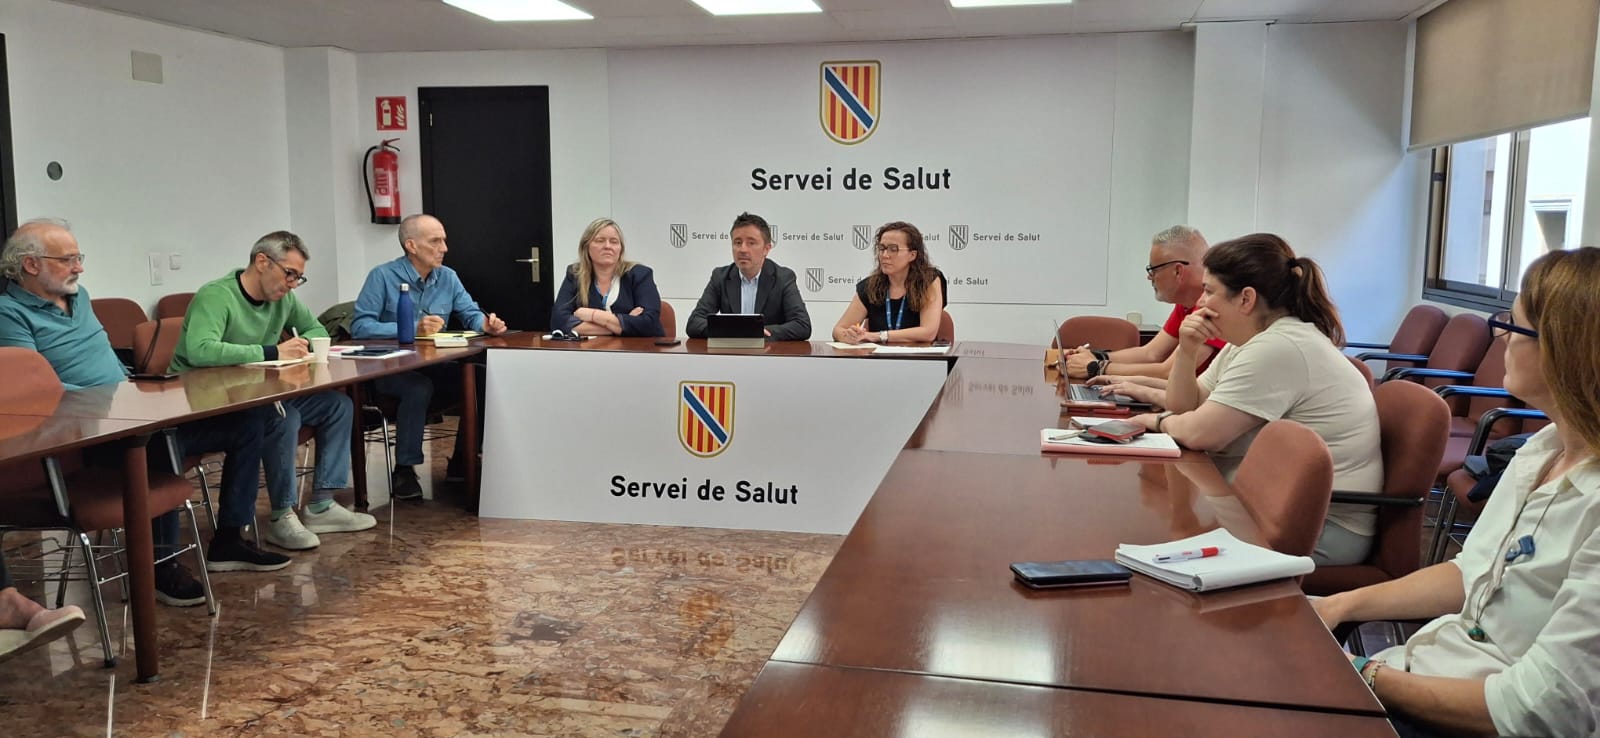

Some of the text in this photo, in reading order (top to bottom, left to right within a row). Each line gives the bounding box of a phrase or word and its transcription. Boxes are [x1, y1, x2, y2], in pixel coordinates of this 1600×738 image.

[751, 166, 951, 191] Servei de Salut
[691, 231, 729, 240] Servei de
[782, 232, 844, 241] Servei de Salut
[921, 232, 940, 241] alut
[973, 232, 1041, 242] Servei de Salut
[827, 275, 855, 285] Servei
[952, 276, 964, 286] de
[966, 276, 989, 286] Salut
[610, 474, 799, 505] Servei de Salut
